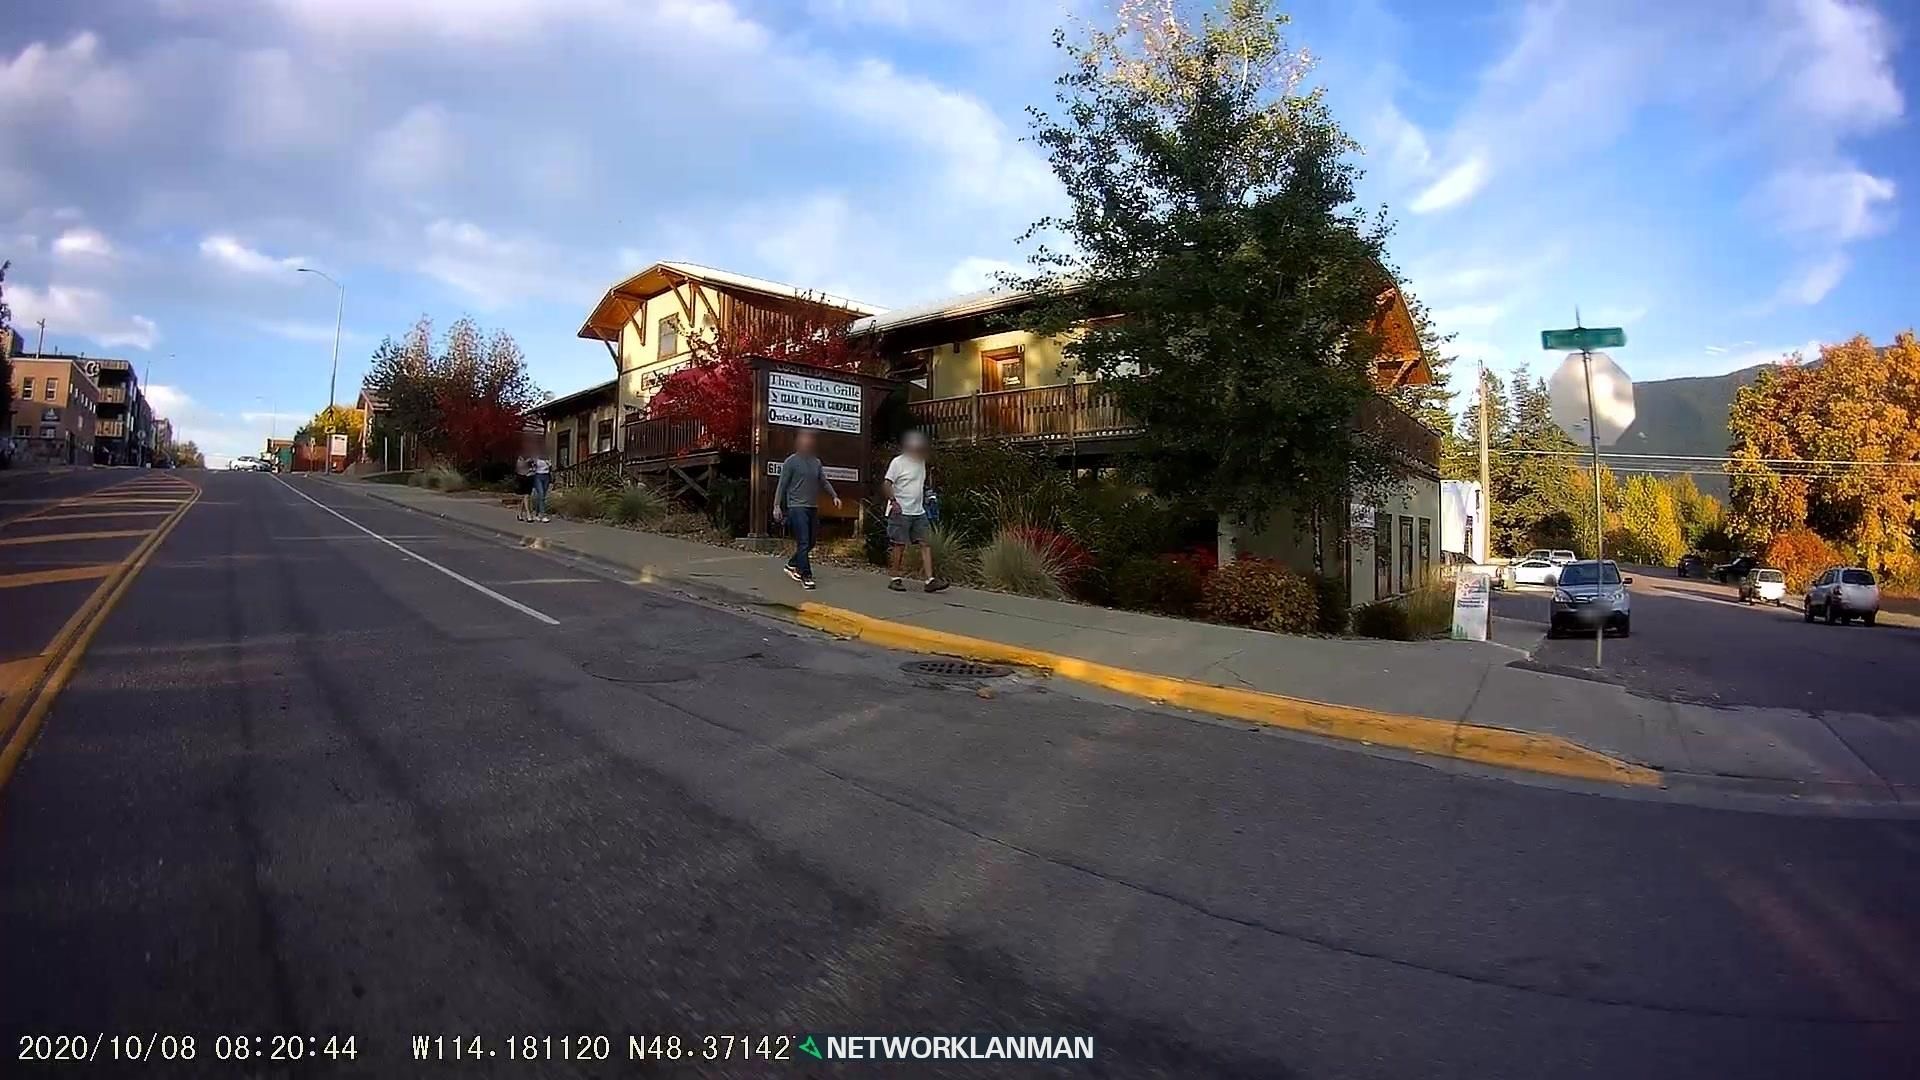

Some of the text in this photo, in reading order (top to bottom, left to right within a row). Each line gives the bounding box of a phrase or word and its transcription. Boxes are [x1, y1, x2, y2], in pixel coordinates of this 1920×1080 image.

[770, 374, 860, 398] Three Forks Grille
[769, 408, 802, 424] Outside
[803, 413, 824, 426] Kids
